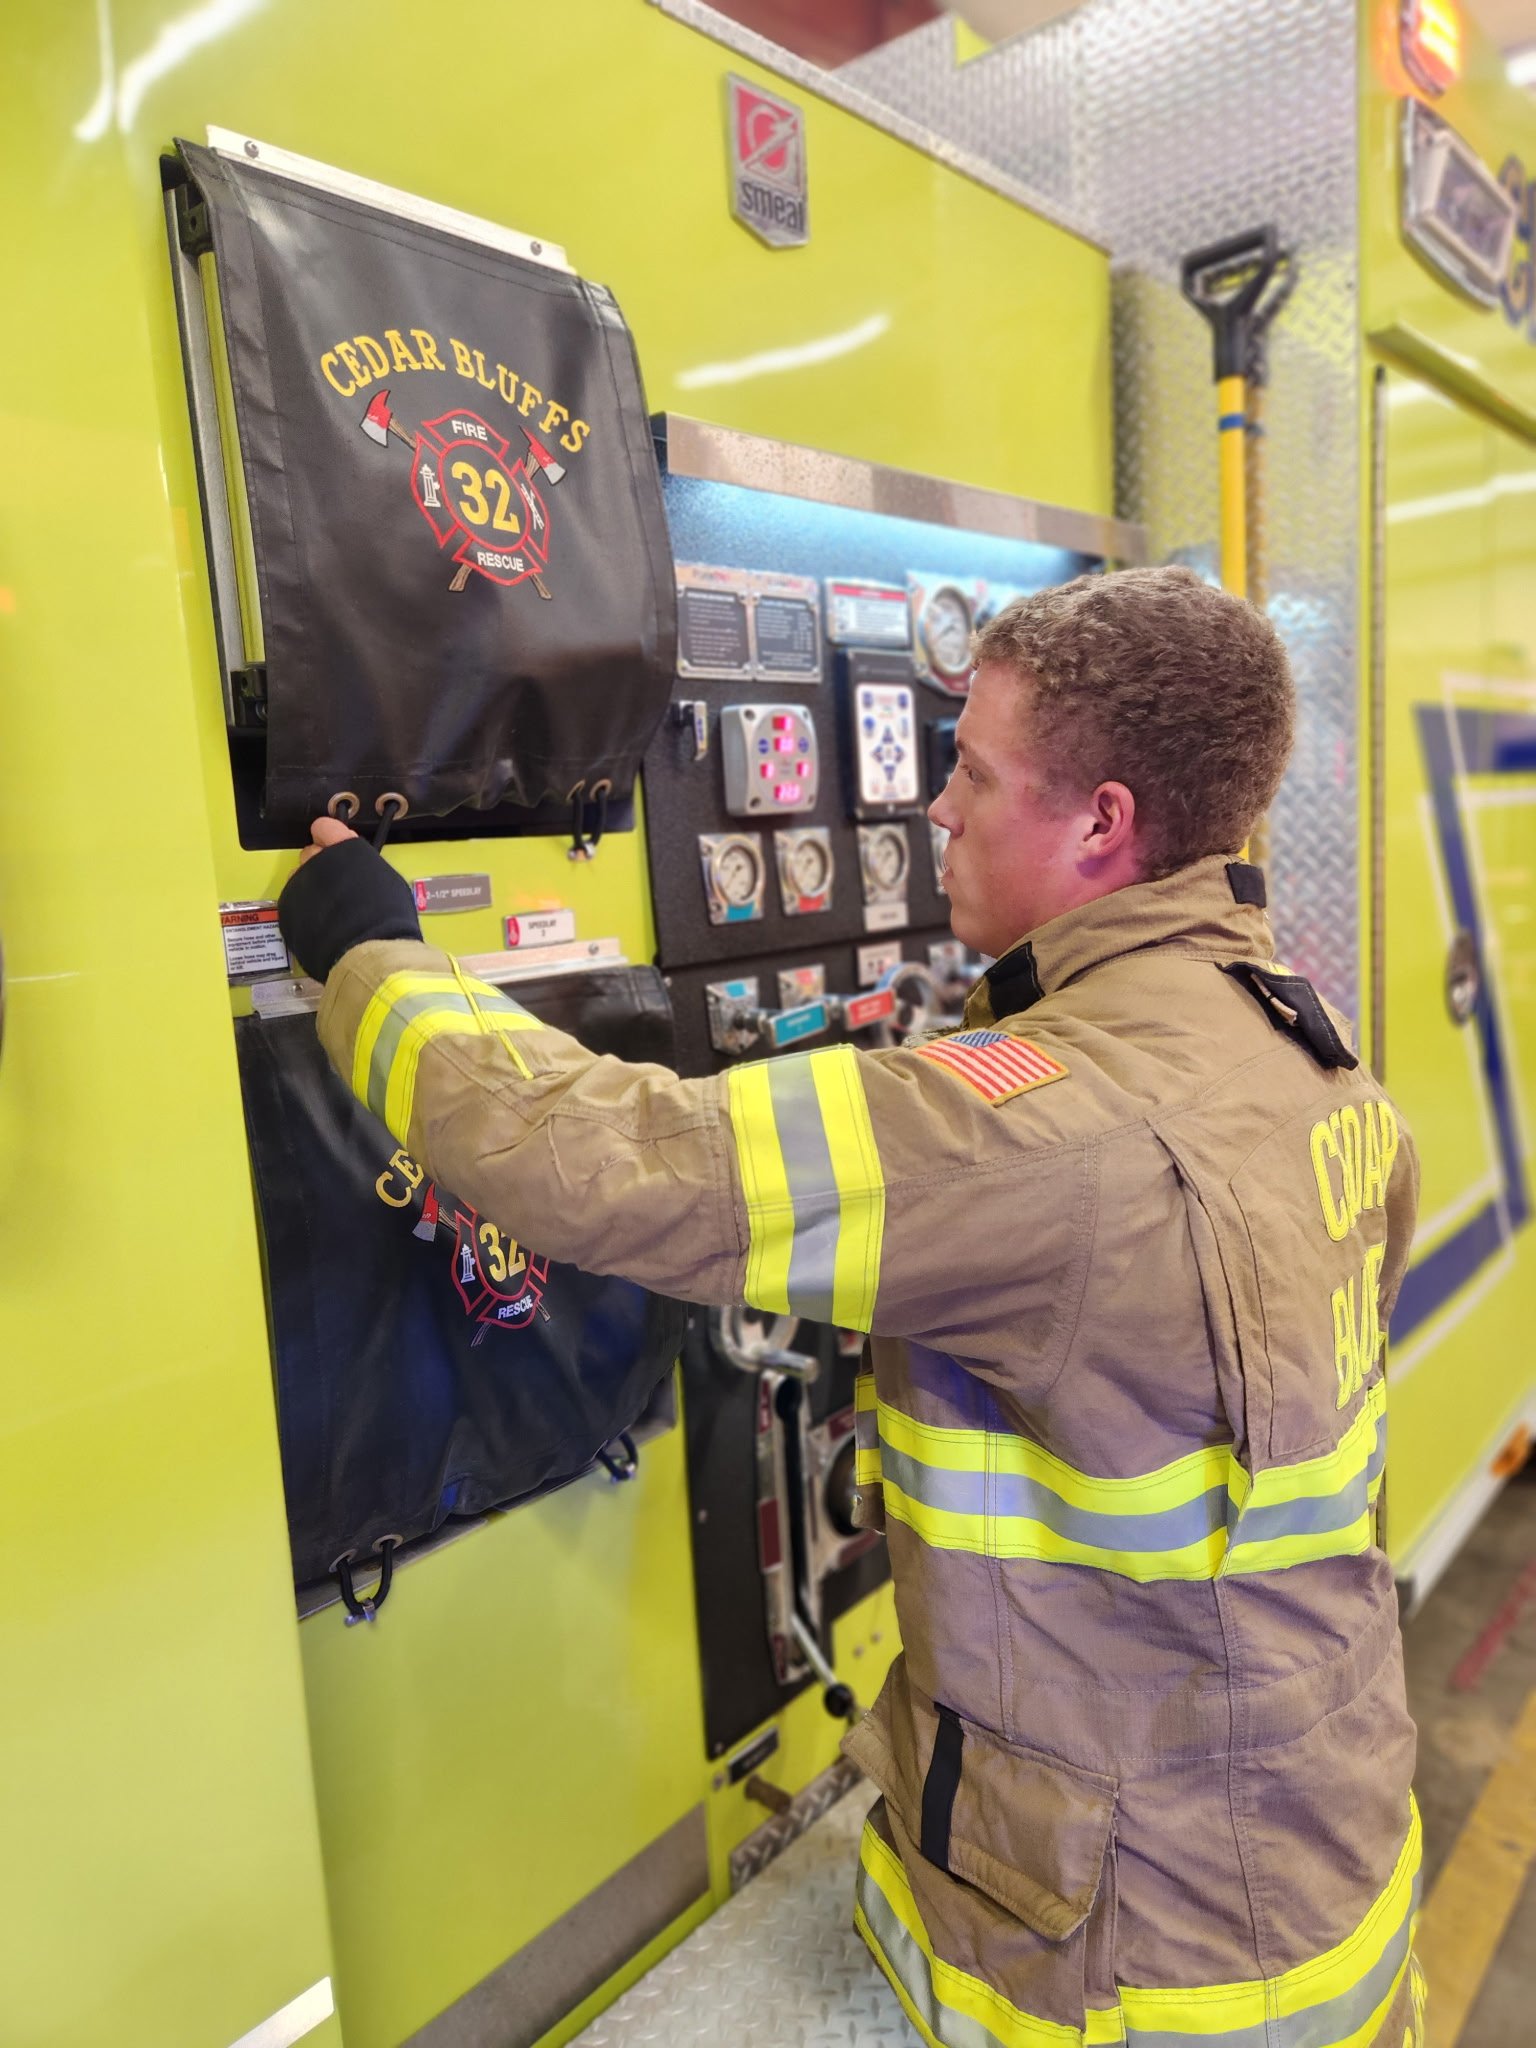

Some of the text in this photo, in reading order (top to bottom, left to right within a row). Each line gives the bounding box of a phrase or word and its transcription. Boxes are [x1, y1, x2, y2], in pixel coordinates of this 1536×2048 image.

[740, 181, 805, 233] smeal
[320, 329, 591, 453] CEDAR BLUFFS
[451, 420, 488, 440] FIRE
[452, 461, 520, 534] 32
[477, 551, 524, 572] RESCUE
[375, 1148, 425, 1208] CE
[497, 1295, 533, 1320] RESCUE
